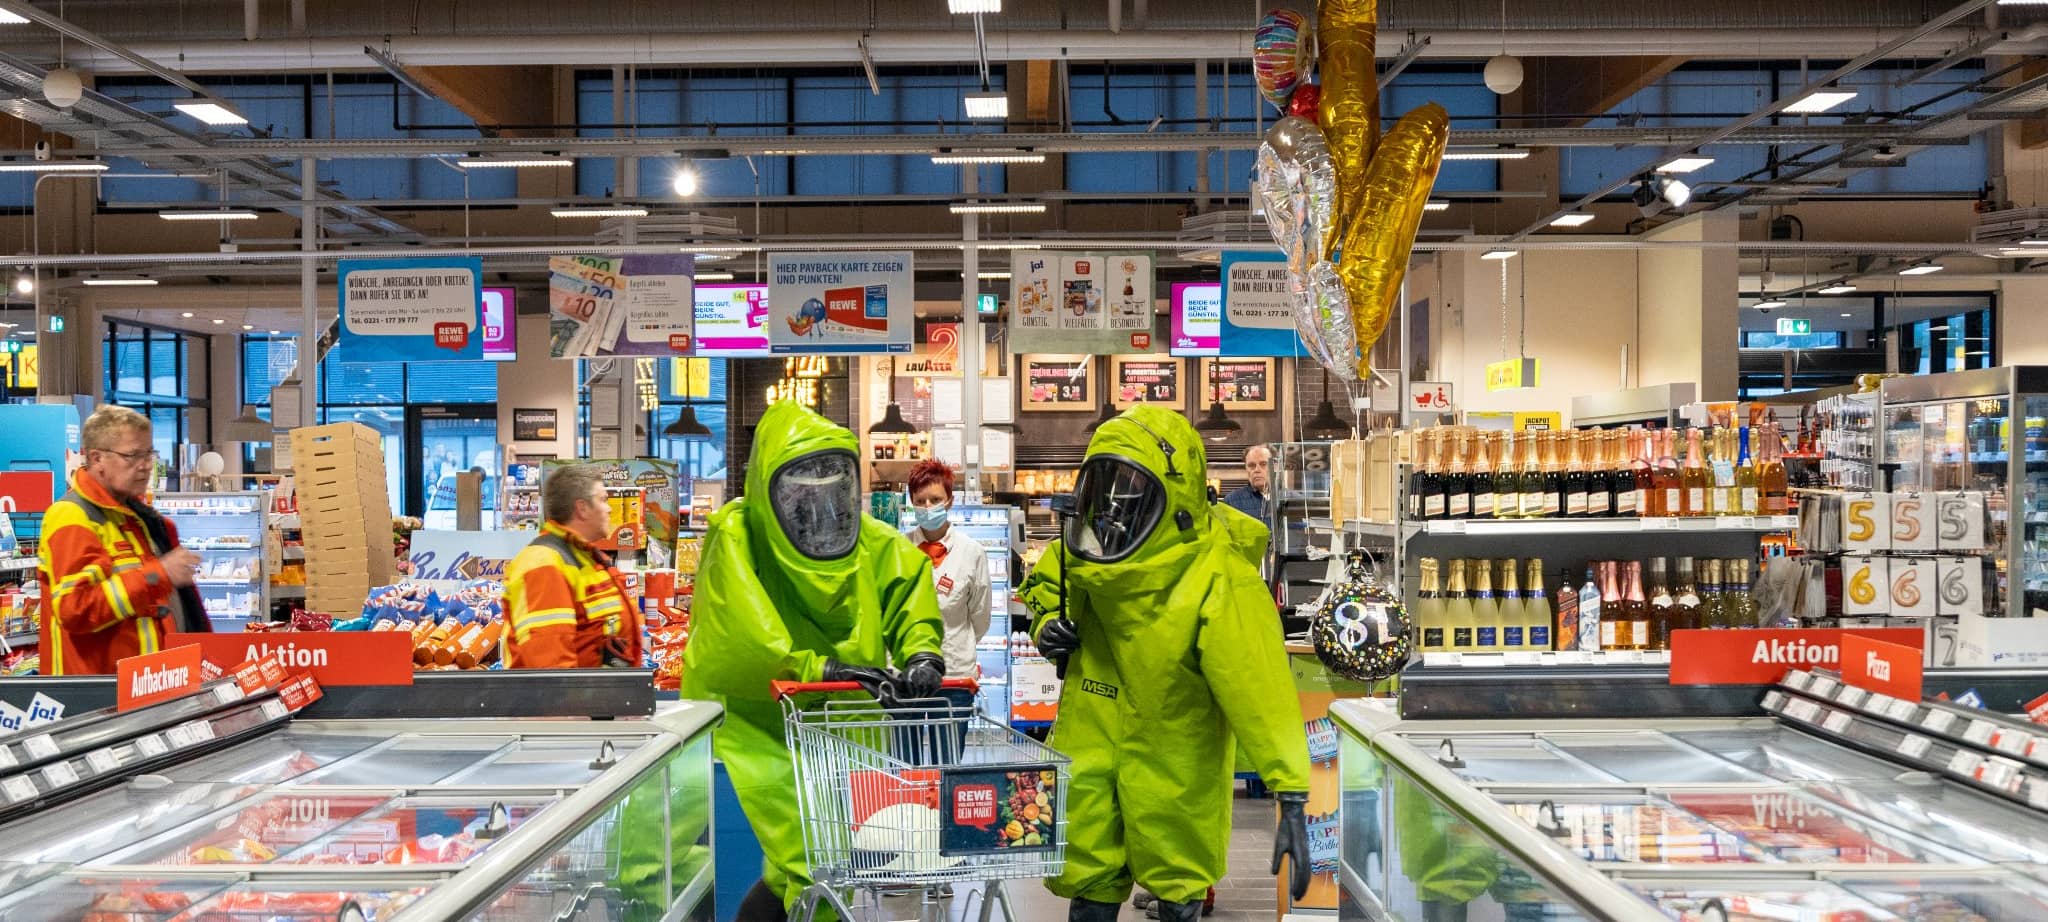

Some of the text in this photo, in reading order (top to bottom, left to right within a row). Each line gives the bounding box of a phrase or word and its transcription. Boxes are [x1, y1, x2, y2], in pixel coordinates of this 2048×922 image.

[776, 262, 903, 273] HIER PAYBACK KARTE ZEIGEN
[1231, 268, 1265, 281] WÜNSCHE,
[349, 275, 469, 288] WÜNSCHE, ANREGUNGEN ODER KRITIK?
[776, 274, 843, 285] UND PUNKTEN!
[1233, 282, 1286, 293] DANN RUFEN SIE
[350, 288, 429, 301] DANN RUFEN SIE UNS AN!
[575, 297, 597, 318] 10
[829, 299, 857, 311] REWE
[438, 327, 464, 335] REWE
[1849, 500, 1876, 542] 5
[1894, 500, 1921, 542] 5
[1940, 499, 1968, 541] 5
[1849, 565, 1876, 605] 6
[1892, 568, 1921, 608] 6
[1941, 566, 1969, 606] 6
[1752, 639, 1838, 665] Aktion
[1938, 626, 1959, 667] 7
[235, 662, 259, 680] REWE
[1866, 651, 1892, 683] Pizza
[131, 664, 189, 699] Aufbackware
[1083, 680, 1116, 698] MSA
[29, 700, 58, 722] ja!
[958, 789, 993, 801] REWE
[958, 807, 993, 819] DEIN MARKT
